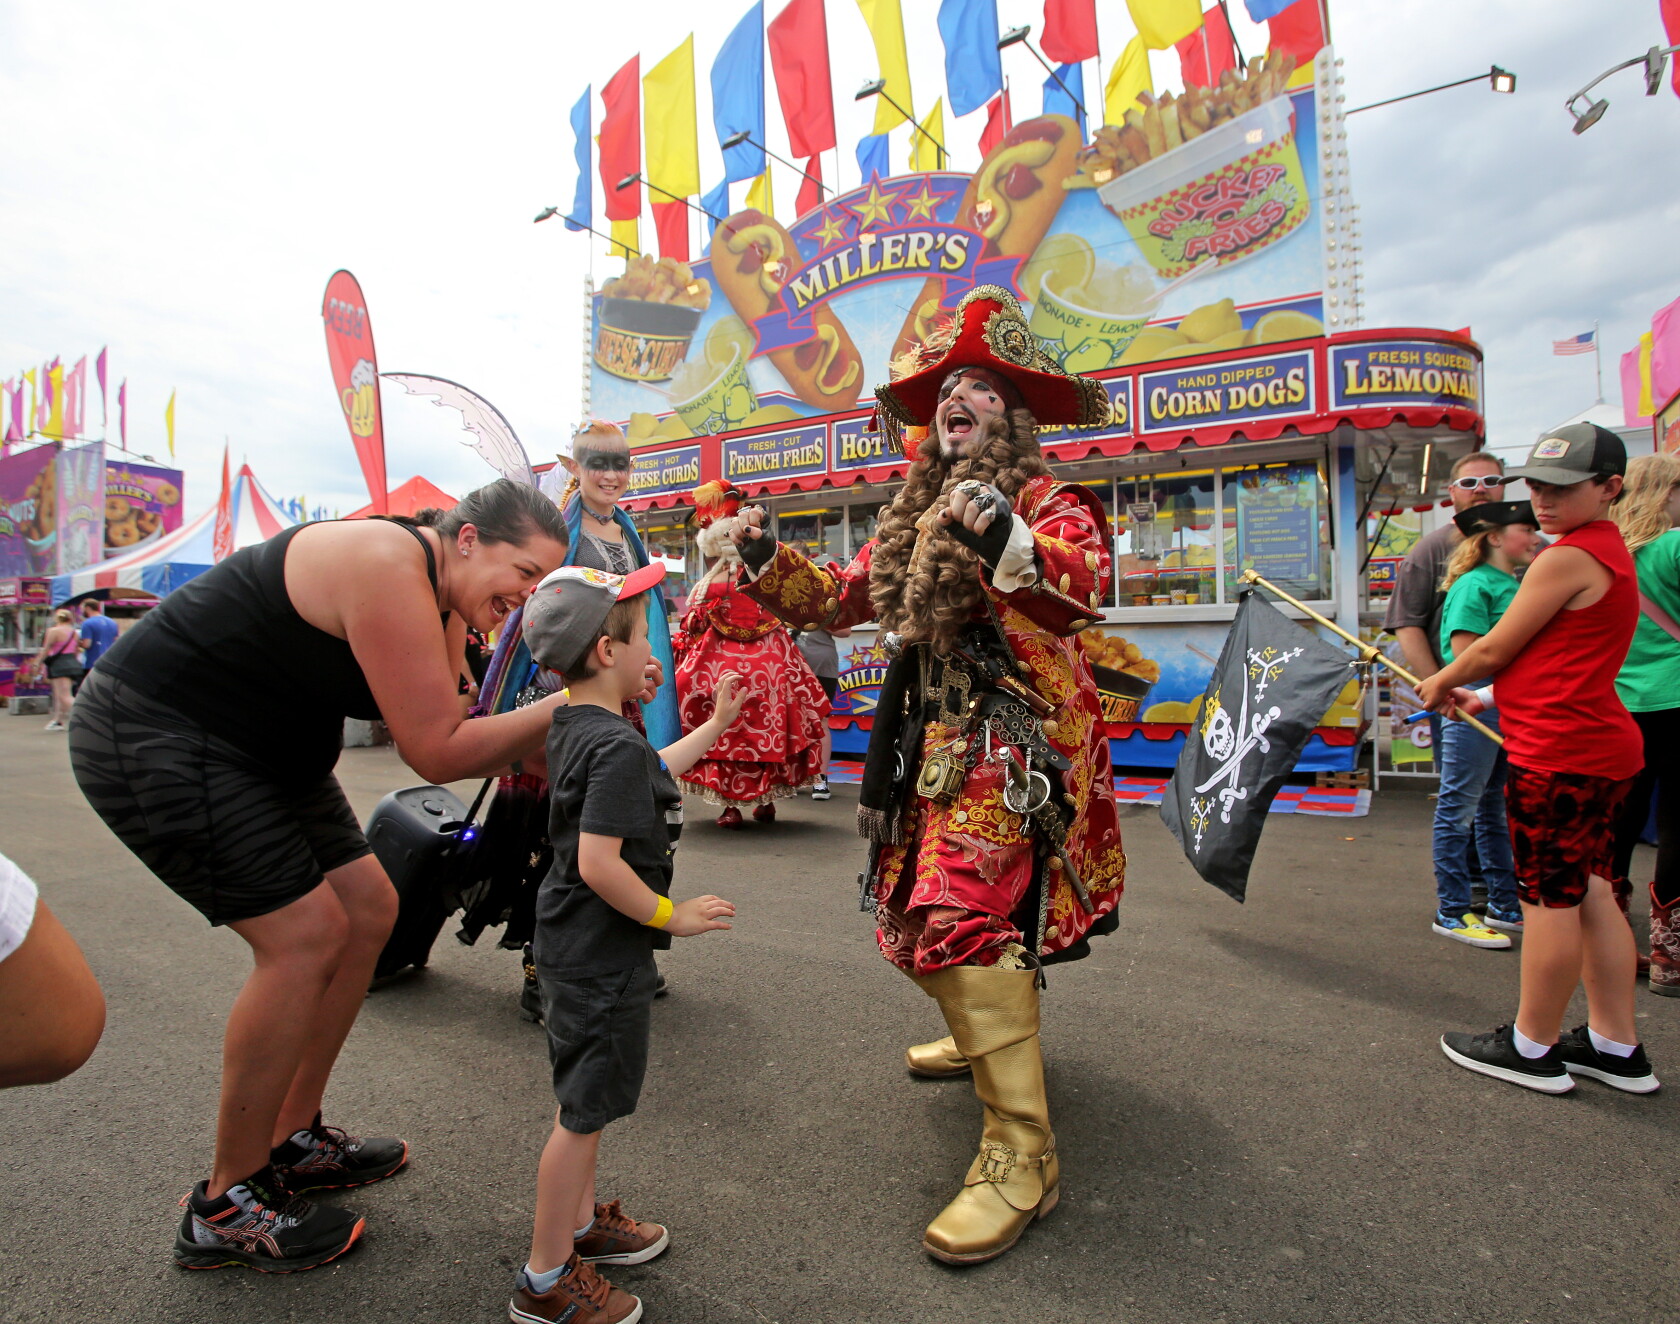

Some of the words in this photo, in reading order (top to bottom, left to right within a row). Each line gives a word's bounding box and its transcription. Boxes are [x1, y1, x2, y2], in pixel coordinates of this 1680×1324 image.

[1148, 164, 1286, 238] BUCKET
[1184, 200, 1286, 261] FRIES
[789, 232, 970, 309] MILLER'S
[1368, 351, 1420, 364] FRESH
[1177, 374, 1217, 389] HAND
[1221, 365, 1276, 384] DIPPED
[1150, 386, 1222, 421] CORN
[1228, 367, 1306, 410] DOGS
[728, 449, 782, 476] FRENCH
[783, 436, 824, 469] FRIES
[748, 440, 776, 451] FRESH
[783, 435, 802, 446] CUT
[840, 433, 885, 460] HOT
[635, 458, 659, 470] FRESH
[665, 455, 680, 466] HOT
[662, 457, 699, 485] CURDS
